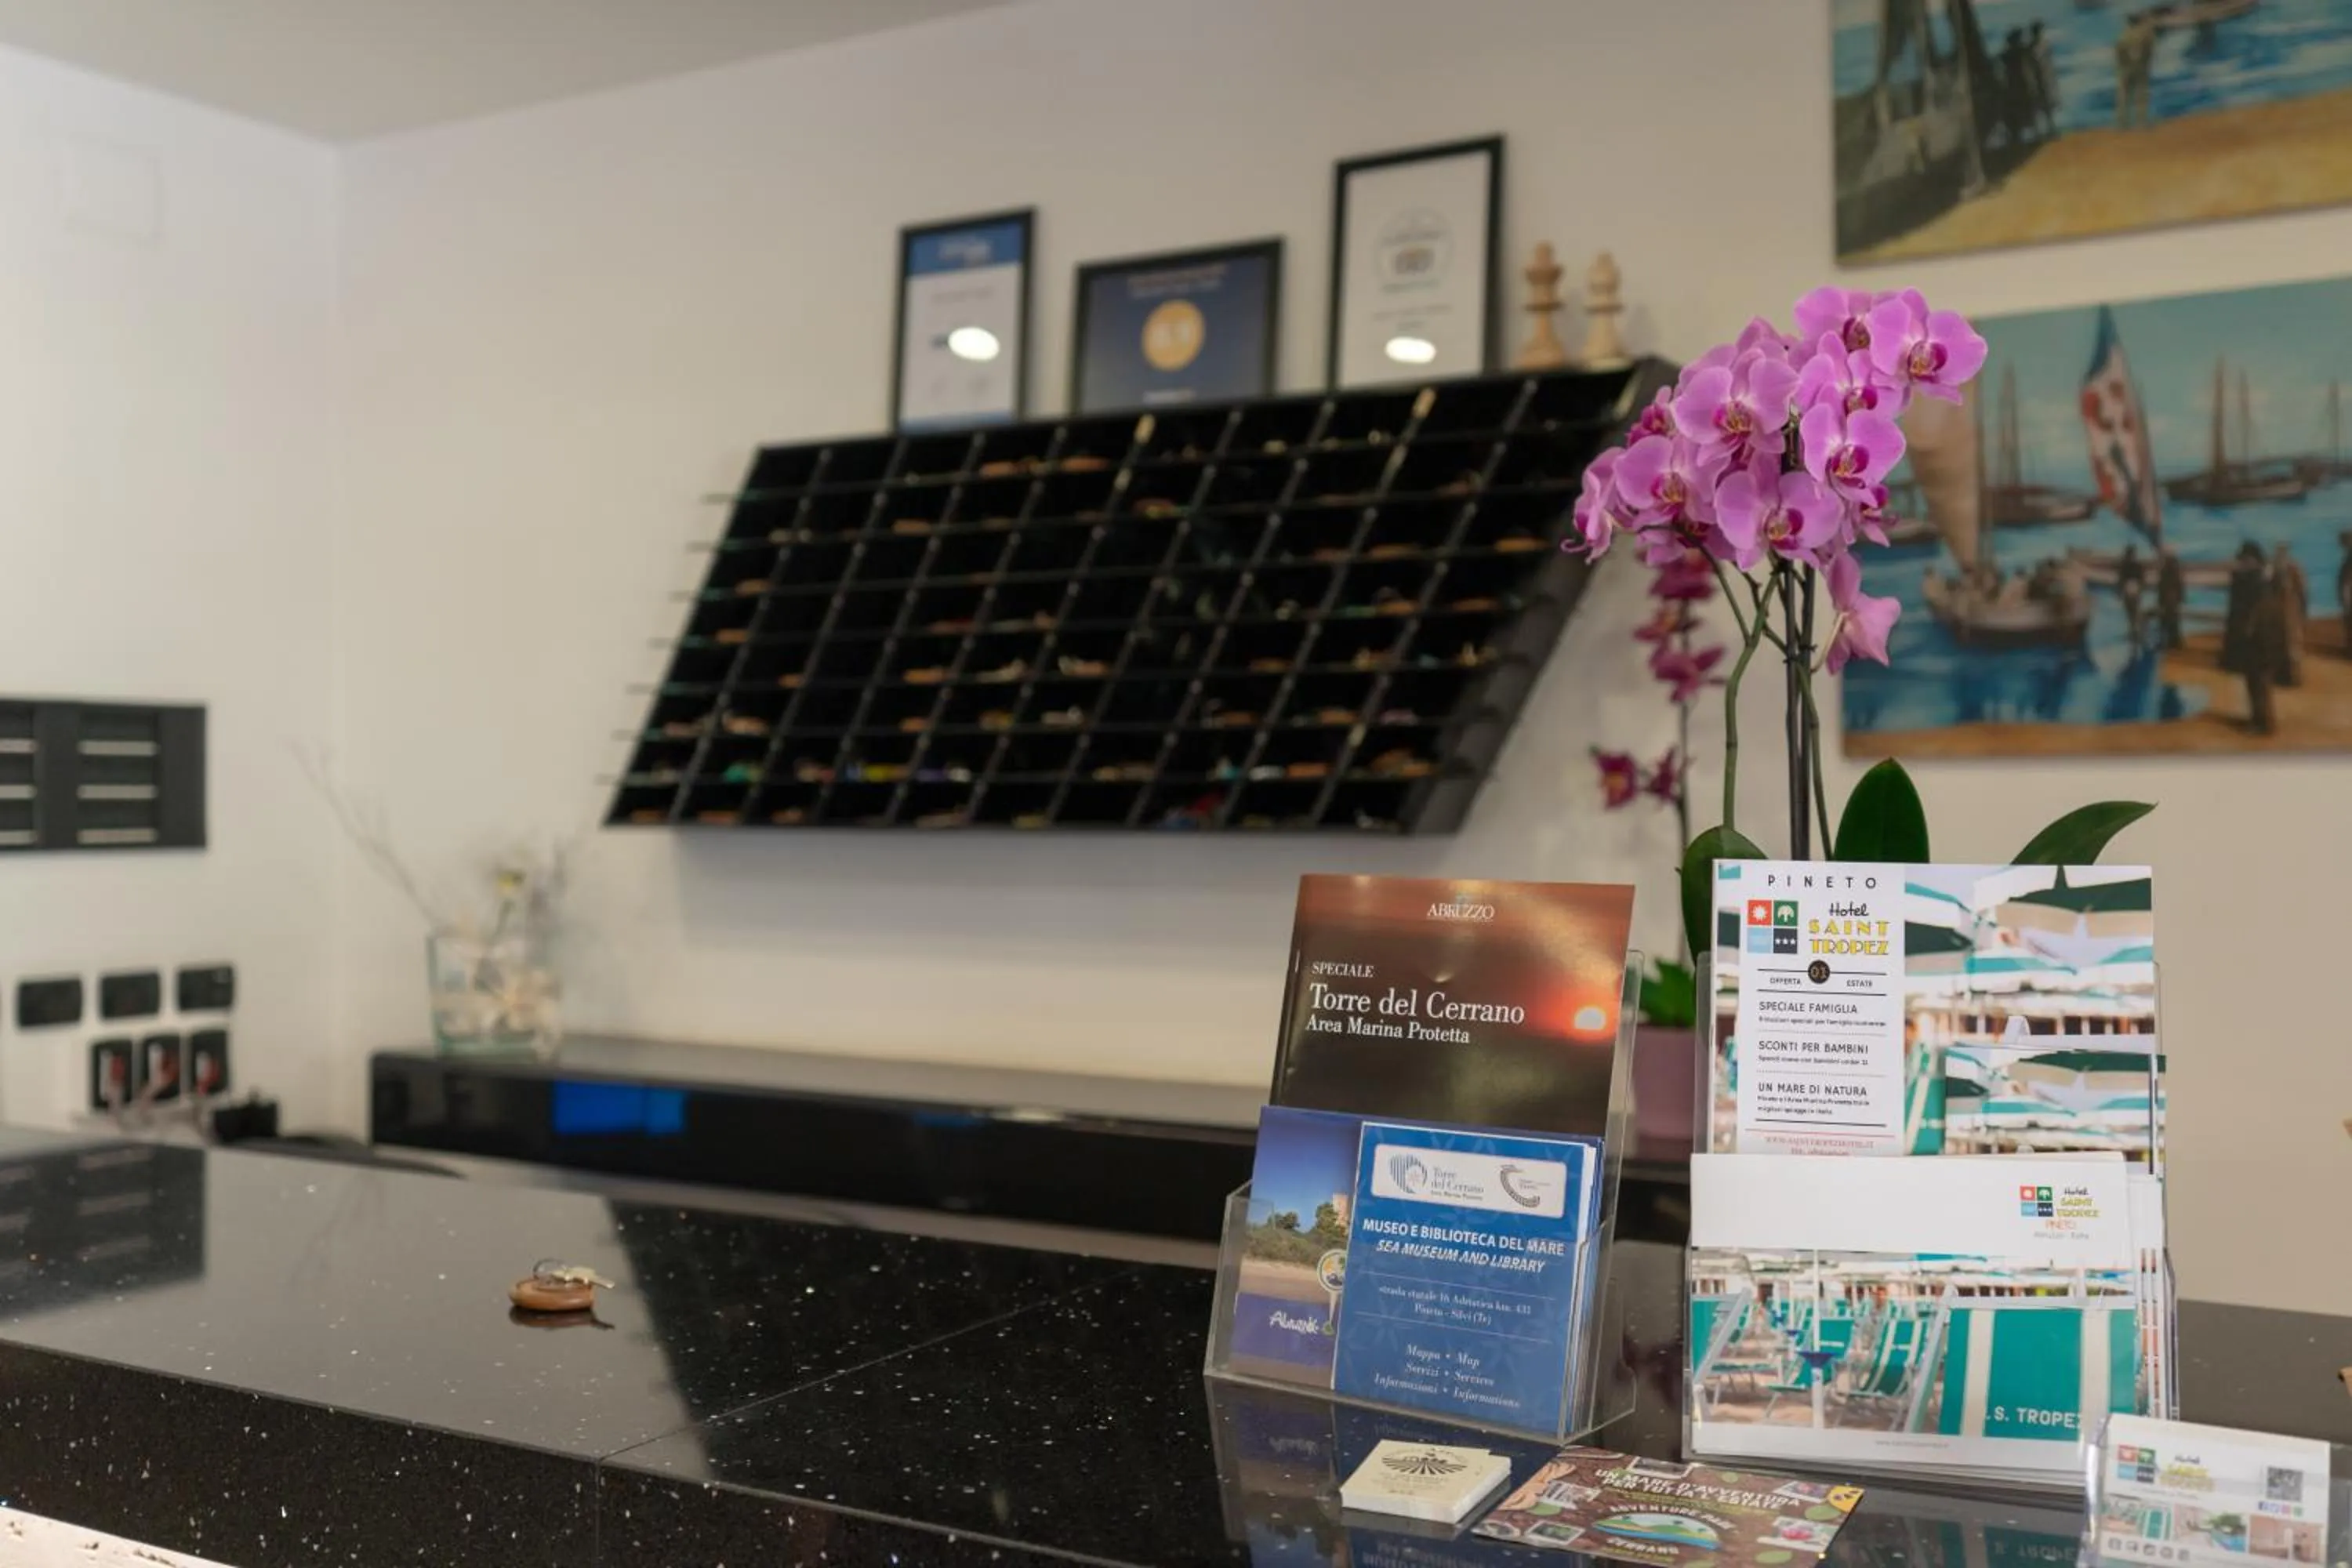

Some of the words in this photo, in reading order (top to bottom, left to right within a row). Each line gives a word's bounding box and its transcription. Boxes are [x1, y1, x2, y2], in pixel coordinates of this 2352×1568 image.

[1768, 874, 1876, 889] PINETO
[1427, 903, 1495, 920] ABRUZZO
[1829, 902, 1869, 916] Hotel
[1808, 918, 1890, 936] SAINT
[1809, 938, 1889, 956] TROPEZ
[1312, 961, 1374, 978] SPECIALE
[1769, 977, 1802, 985] OFFERTA
[1846, 979, 1873, 988] ESTATE
[1310, 982, 1371, 1012] Torre
[1379, 989, 1417, 1016] del
[1426, 992, 1525, 1024] Cerrano
[1759, 1000, 1806, 1012] SPECIALE
[1809, 1003, 1858, 1014] FAMIGLIA
[1305, 1014, 1342, 1033] Area
[1347, 1017, 1403, 1039] Marina
[1407, 1022, 1470, 1044] Protetta
[1759, 1040, 1798, 1052] SCONTI
[1802, 1042, 1820, 1053] PER
[1824, 1043, 1869, 1054] BAMBINI
[1758, 1083, 1773, 1092] UN
[1777, 1083, 1806, 1094] MARE
[1809, 1084, 1820, 1094] DI
[1824, 1085, 1867, 1097] NATURA
[1363, 1218, 1408, 1236] MUSEO
[1411, 1225, 1418, 1236] E
[1421, 1226, 1497, 1247] BIBLIOTECA
[1499, 1236, 1524, 1251] DEL
[1526, 1239, 1566, 1255] MARE
[1376, 1239, 1401, 1253] SEA
[1402, 1243, 1458, 1261] MUSEUM
[1459, 1250, 1490, 1265] AND
[1490, 1254, 1545, 1273] LIBRARY
[1406, 1344, 1440, 1361] Mappa
[1456, 1352, 1480, 1369] Map
[1374, 1373, 1438, 1394] Informazioni
[1994, 1406, 2009, 1421] S.
[1595, 1469, 1619, 1479] UN
[1624, 1474, 1670, 1487] MARE
[1643, 1483, 1694, 1497] TUTTA
